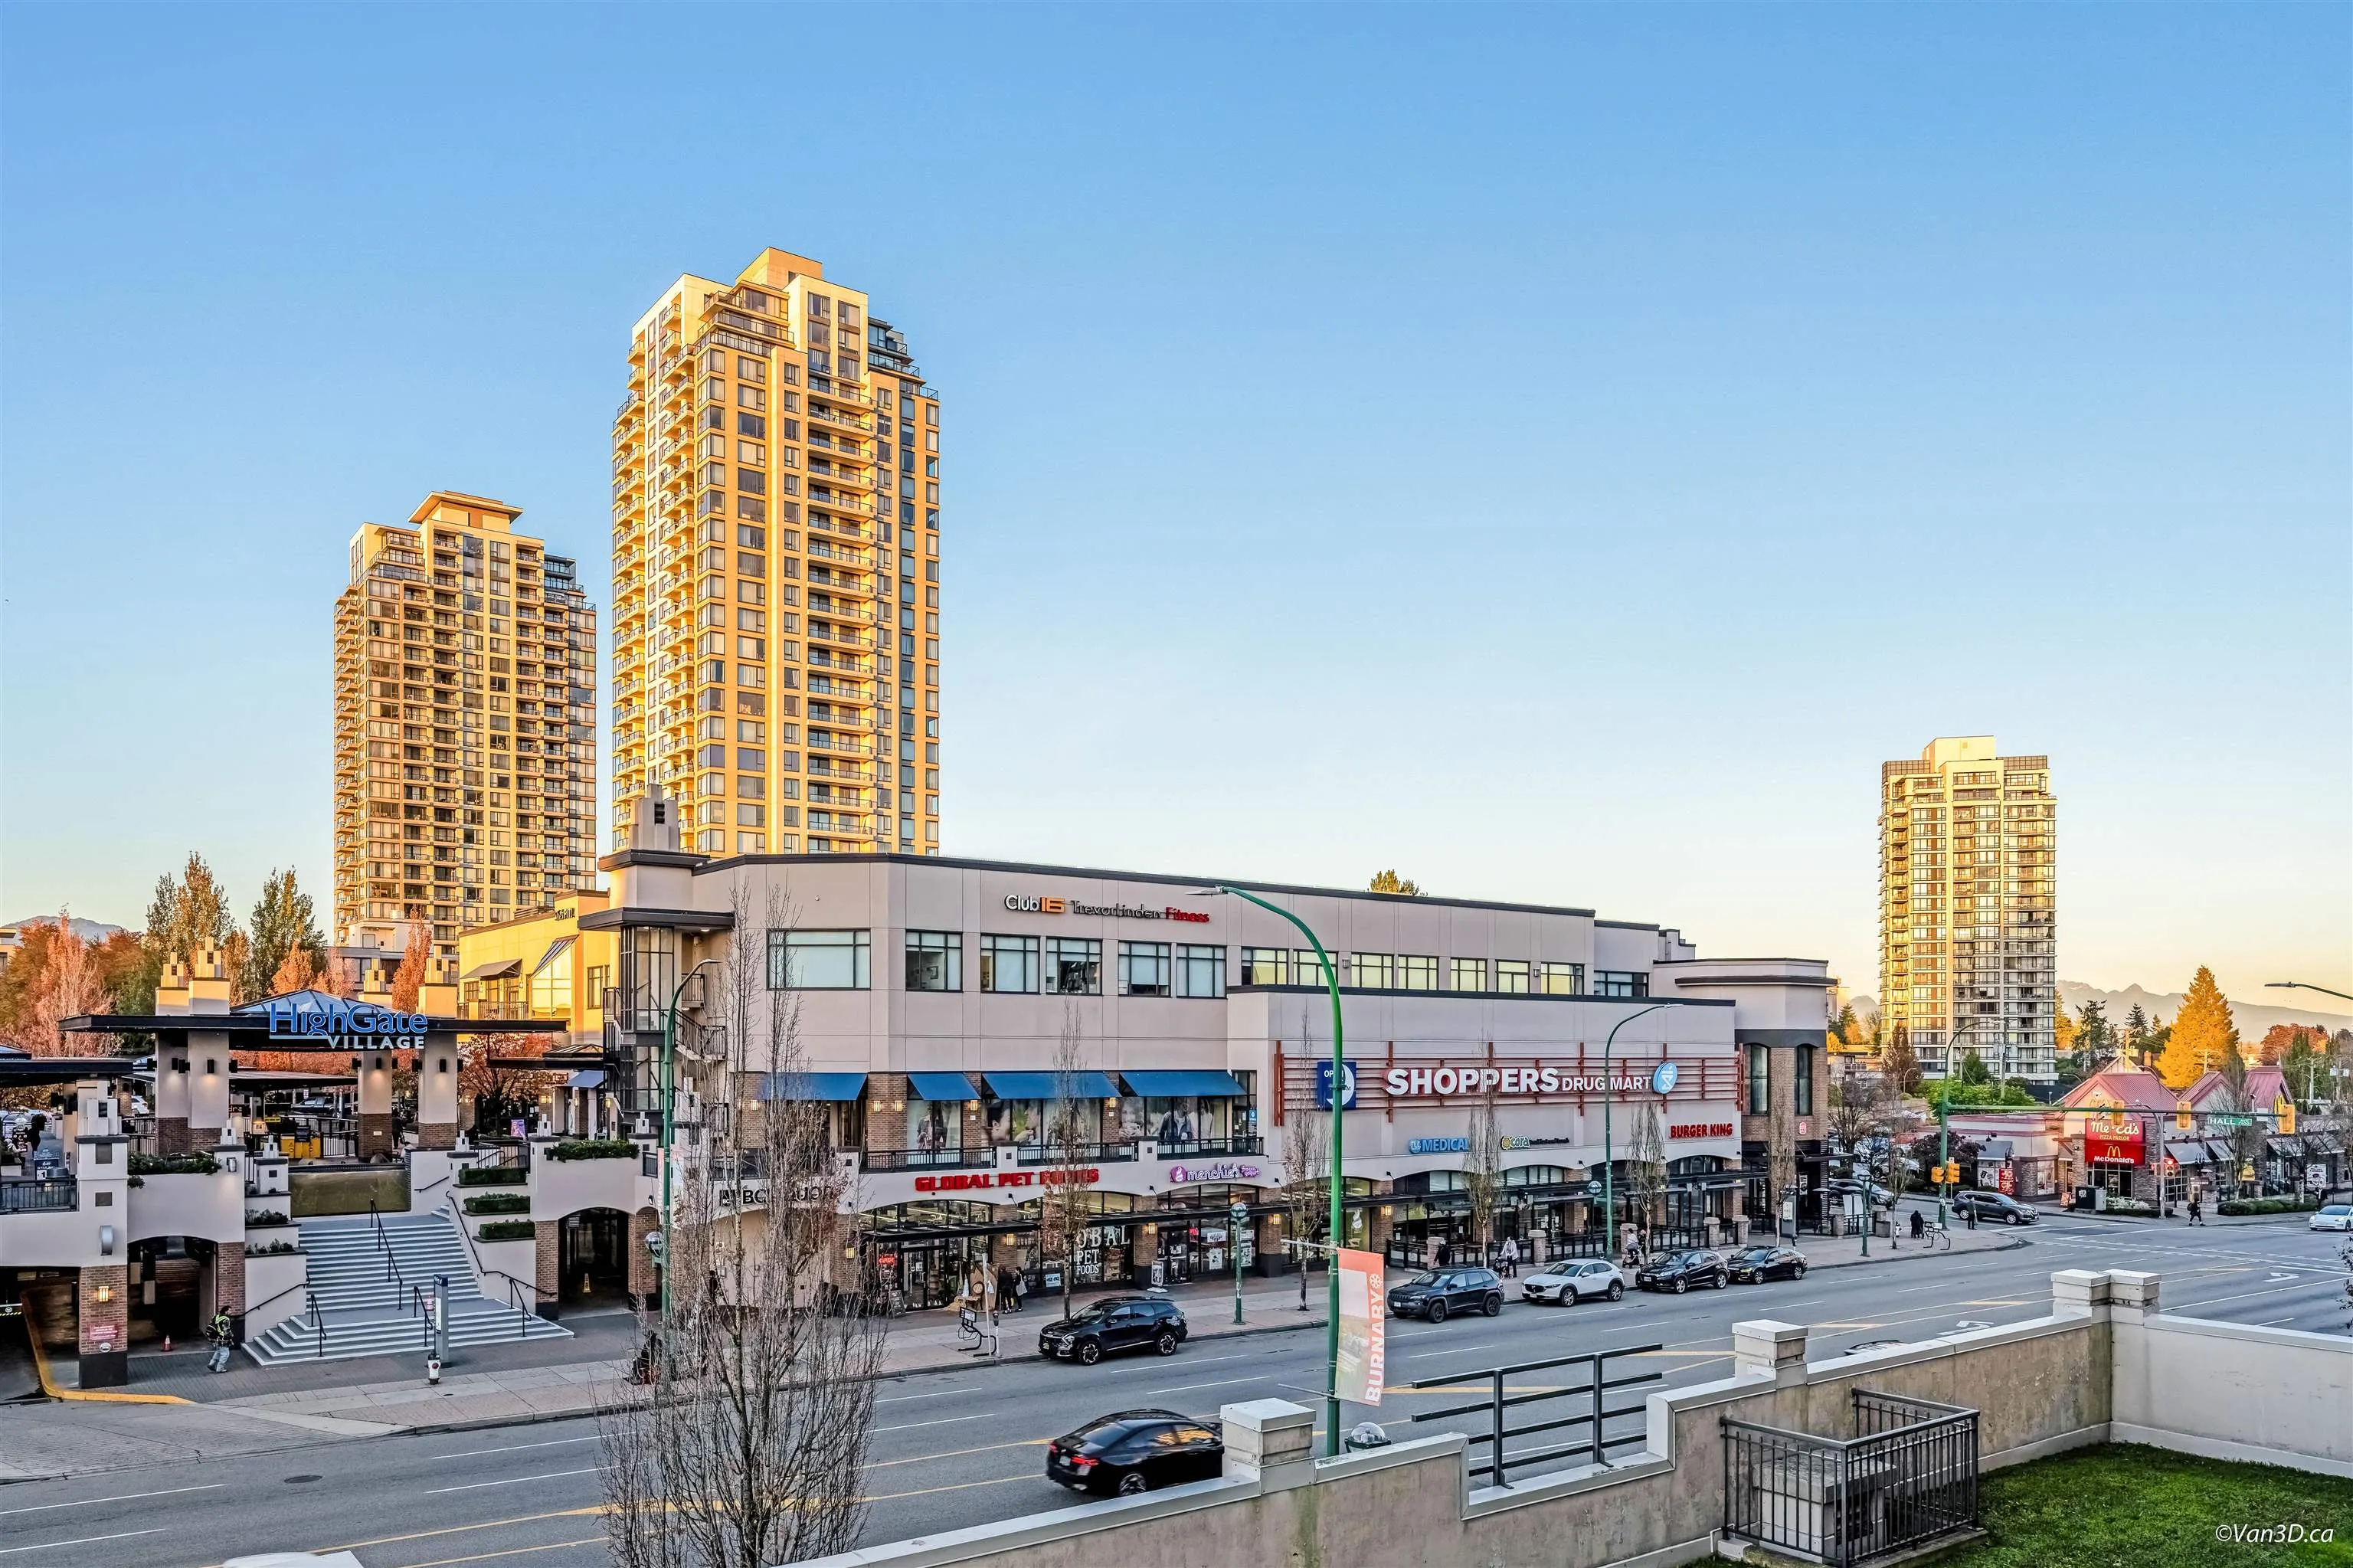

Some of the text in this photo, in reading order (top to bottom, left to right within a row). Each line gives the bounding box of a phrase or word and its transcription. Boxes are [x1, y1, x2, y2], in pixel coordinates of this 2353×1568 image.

[270, 1003, 428, 1036] HighGate
[328, 1036, 425, 1049] VILLAGE
[1386, 1067, 1651, 1095] SHOPPERS DRUG MART
[1671, 1123, 1733, 1138] BURGER KING
[915, 1175, 994, 1191] GLOBAL
[998, 1171, 1035, 1187] PET
[1076, 1249, 1100, 1265] PET
[1077, 1264, 1100, 1275] FOODS
[1365, 1290, 1383, 1401] BURNABY
